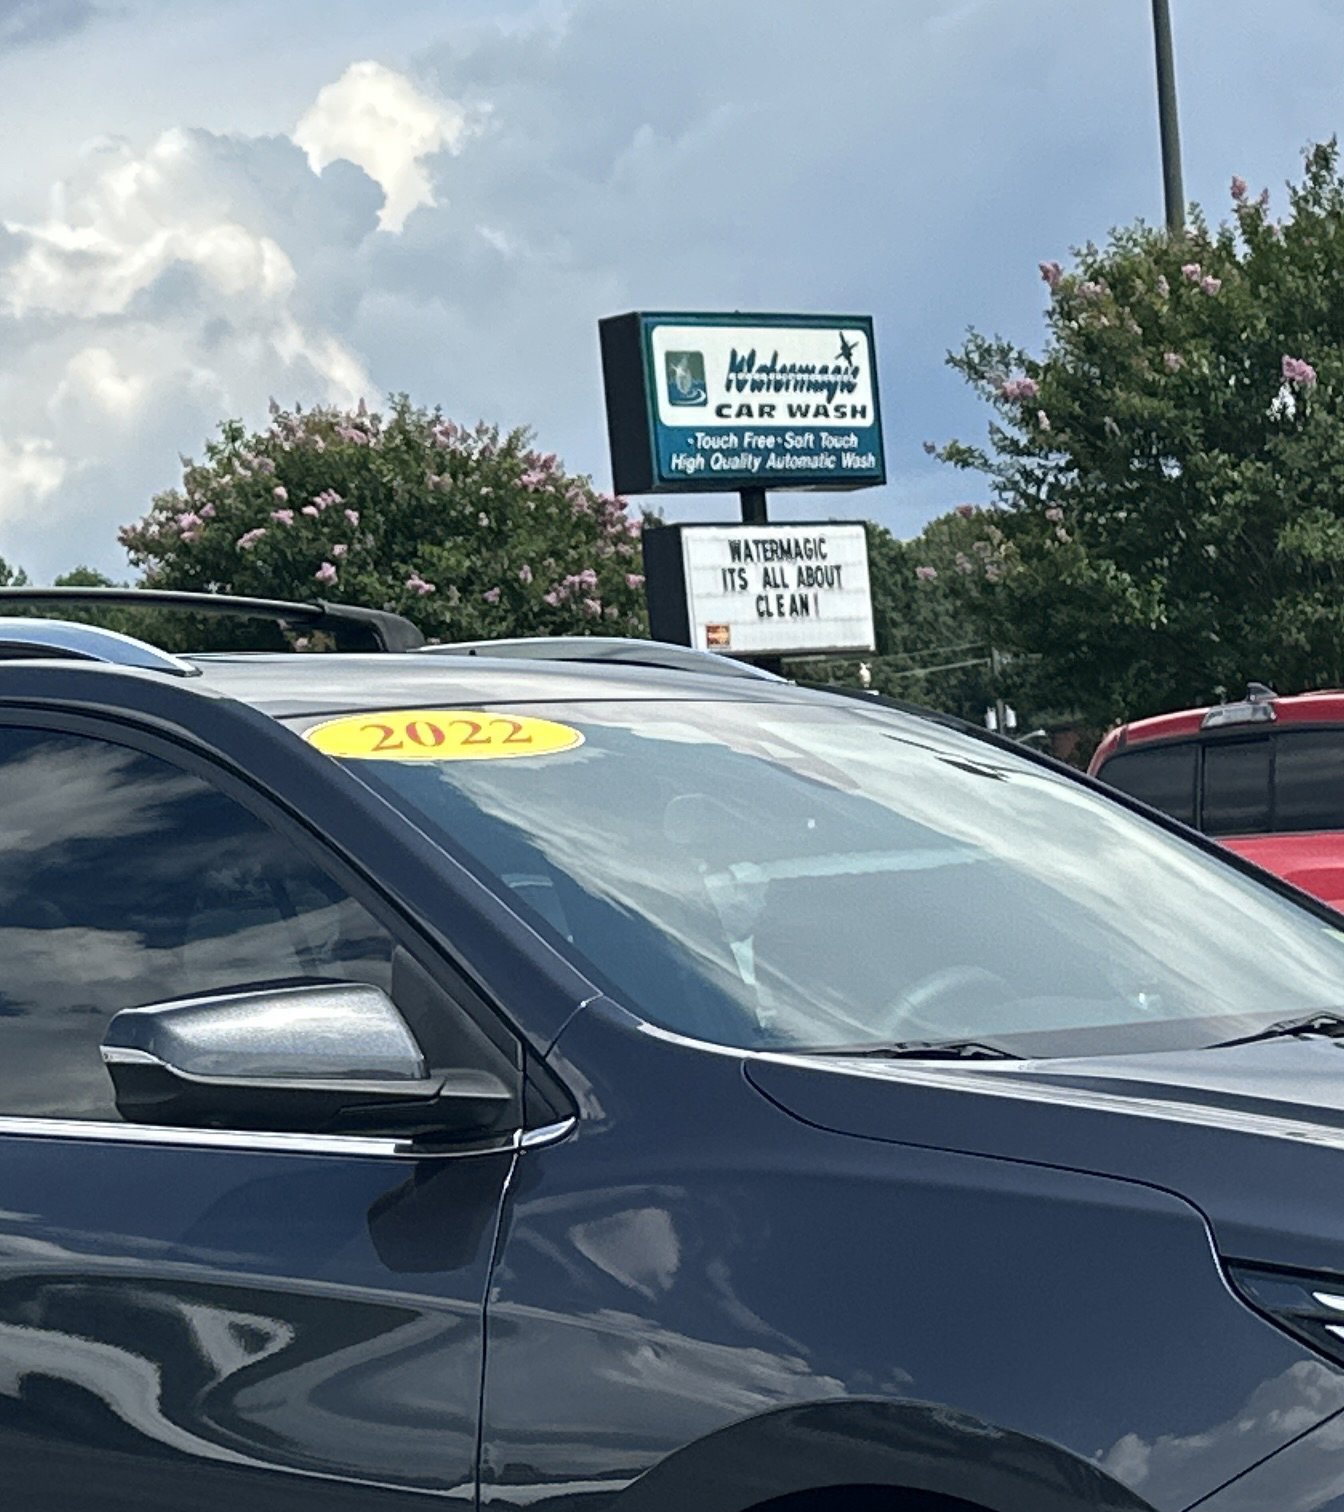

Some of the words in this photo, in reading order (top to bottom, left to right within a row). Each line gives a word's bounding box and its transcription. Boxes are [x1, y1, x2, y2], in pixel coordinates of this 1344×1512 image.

[715, 403, 777, 418] CAR
[787, 403, 867, 418] WASH
[695, 432, 738, 449] Touch
[744, 432, 775, 449] Free
[783, 431, 815, 449] Soft
[820, 432, 859, 448] Touch
[671, 454, 705, 474] High
[710, 453, 761, 473] Quality
[765, 452, 836, 469] Automatic
[841, 451, 875, 469] Wash
[727, 537, 827, 562] WATERMAGIC
[721, 567, 748, 591] ITS
[763, 566, 789, 589] ALL
[797, 565, 842, 590] ABOUT
[360, 719, 533, 751] 2022
